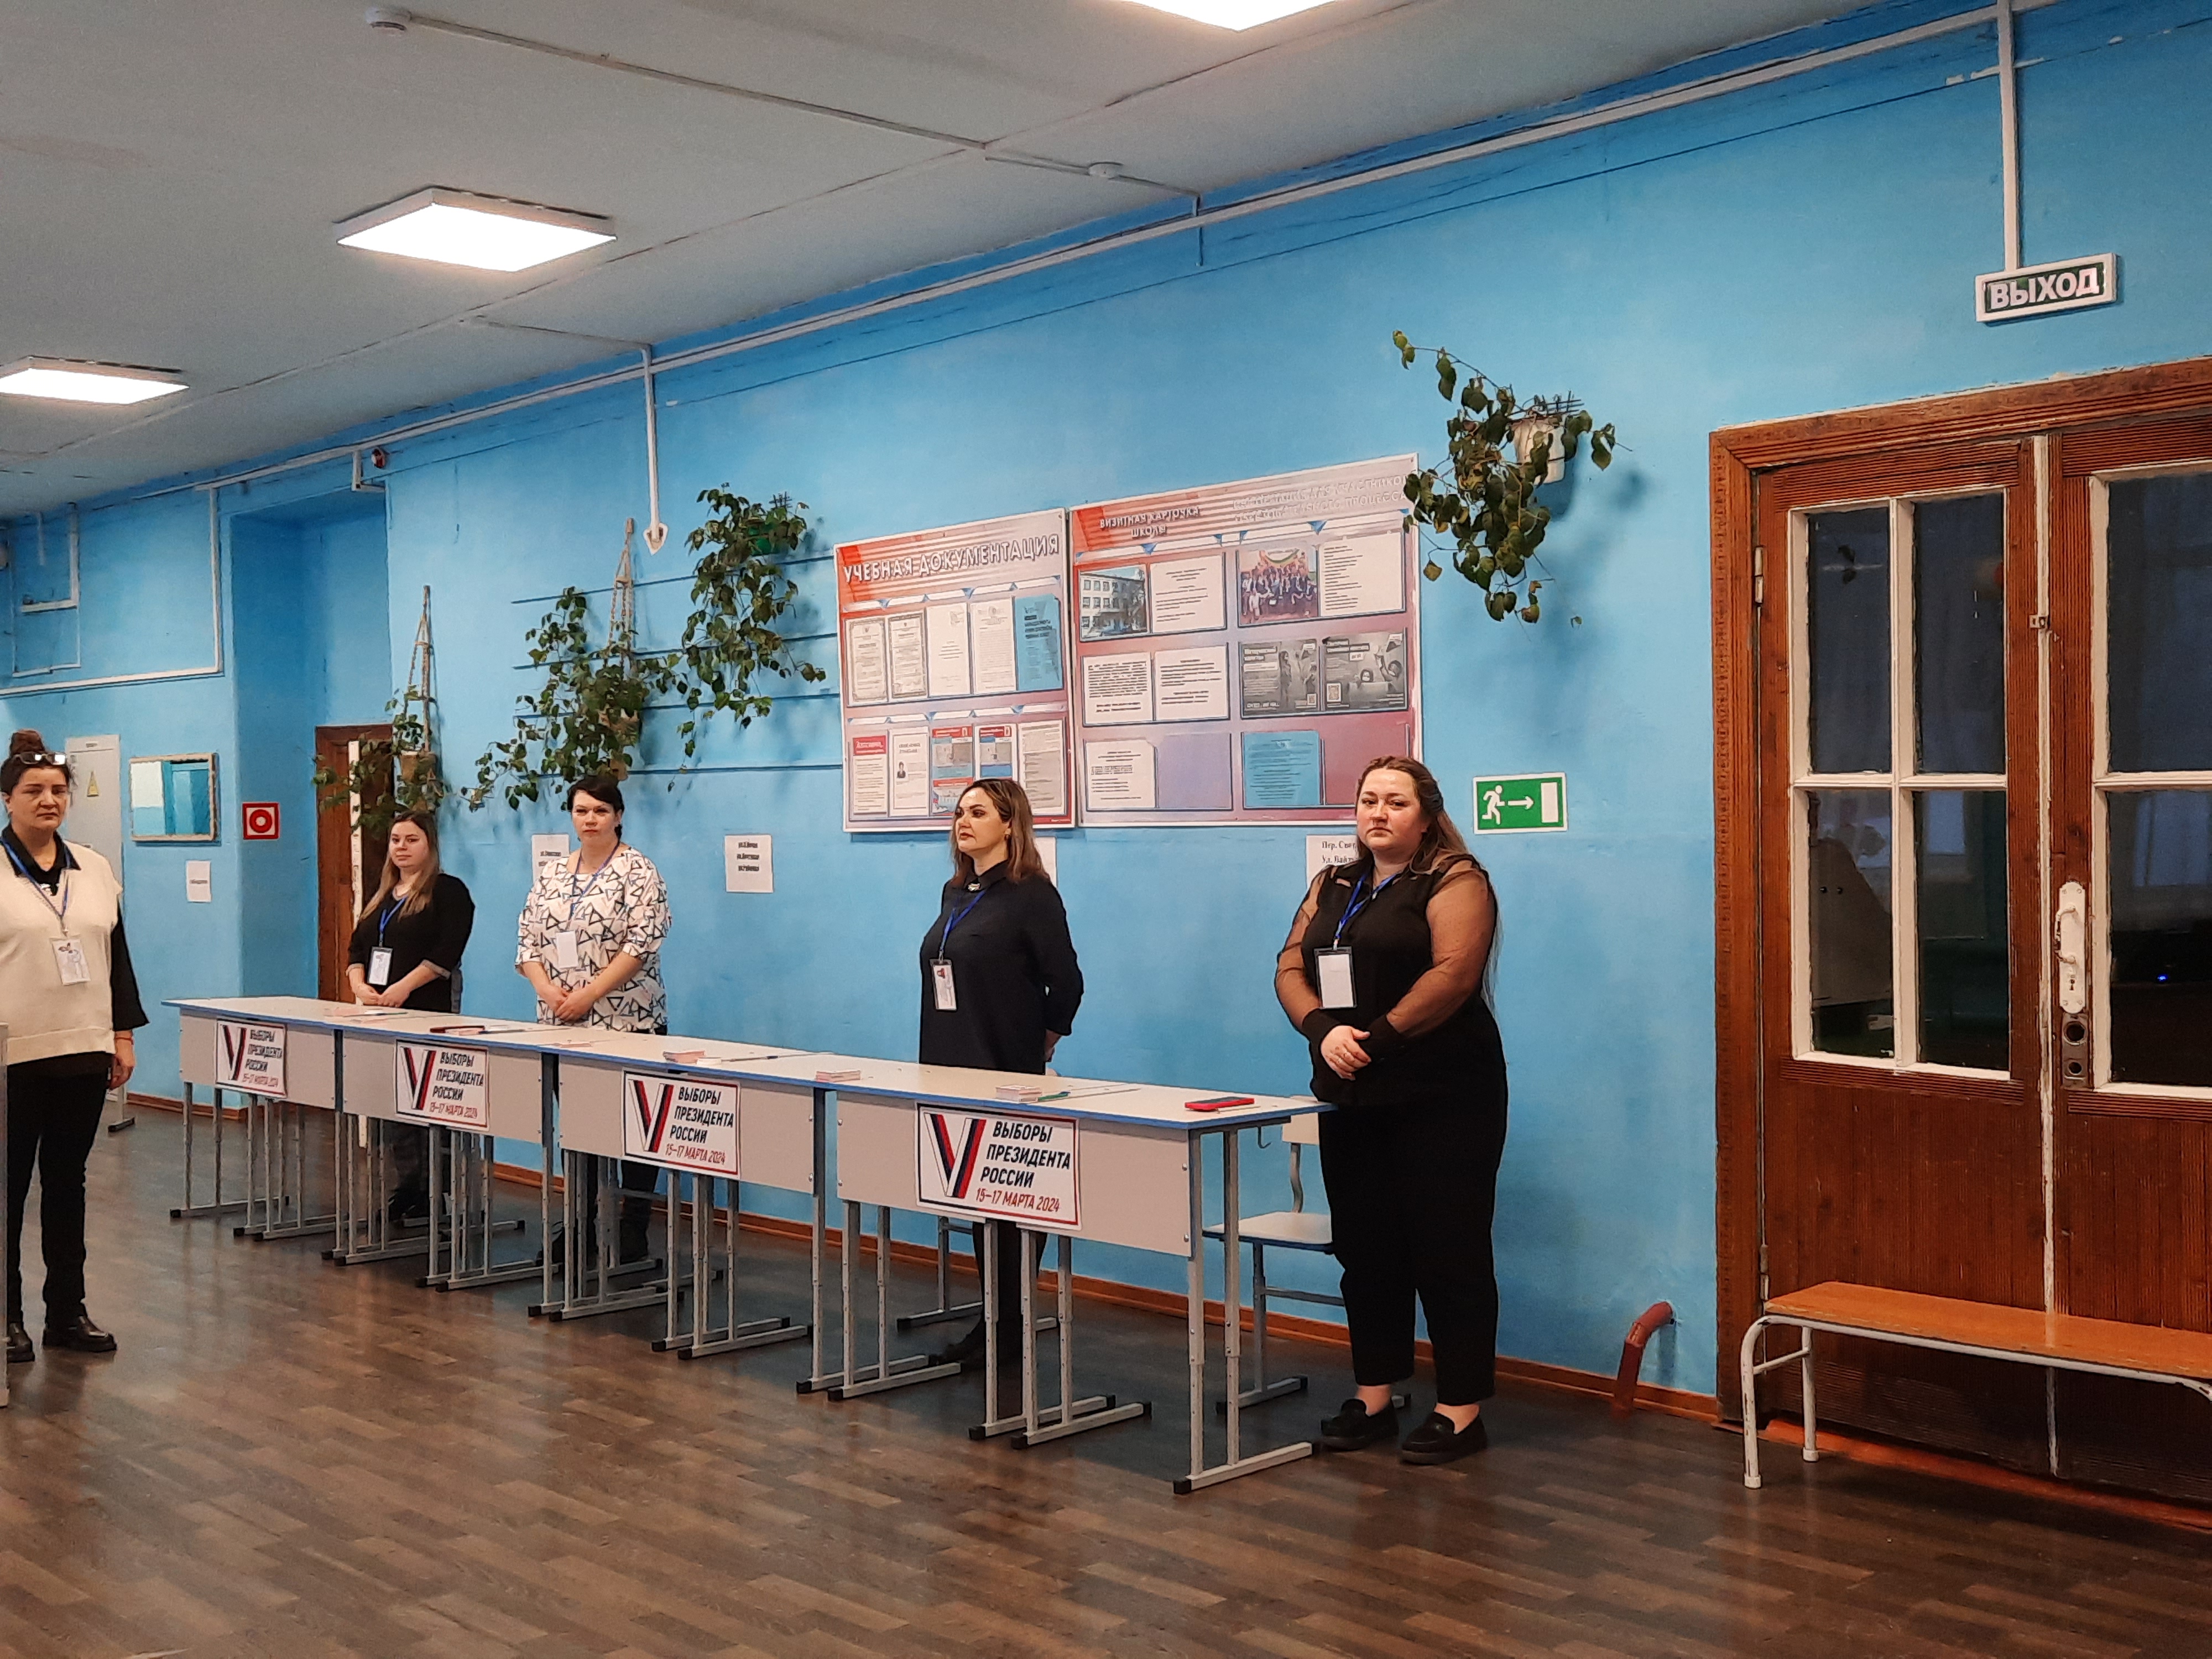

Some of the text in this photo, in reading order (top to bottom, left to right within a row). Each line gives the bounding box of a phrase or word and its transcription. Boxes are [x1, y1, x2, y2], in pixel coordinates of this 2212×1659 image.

[1990, 268, 2099, 310] ВЫХОД
[1148, 506, 1201, 523] КАРТОЧКА
[843, 534, 1060, 583] УЧЕБНАЯ ДОКУМЕНТАЦИЯ
[440, 1052, 474, 1067] ВЫБОРЫ
[436, 1068, 484, 1087] ПРЕЗИДЕНТА
[432, 1086, 463, 1101] РОССИИ
[678, 1086, 722, 1105] ВЫБОРЫ
[674, 1105, 734, 1128] ПРЕЗИДЕНТА
[670, 1124, 708, 1144] РОССИИ
[993, 1121, 1053, 1143] ВЫБОРЫ
[685, 1146, 707, 1162] МАРТА
[986, 1144, 1071, 1170] ПРЕЗИДЕНТА
[980, 1166, 1034, 1188] РОССИИ
[1002, 1191, 1035, 1209] МАРТА
[1036, 1196, 1061, 1213] 2024
